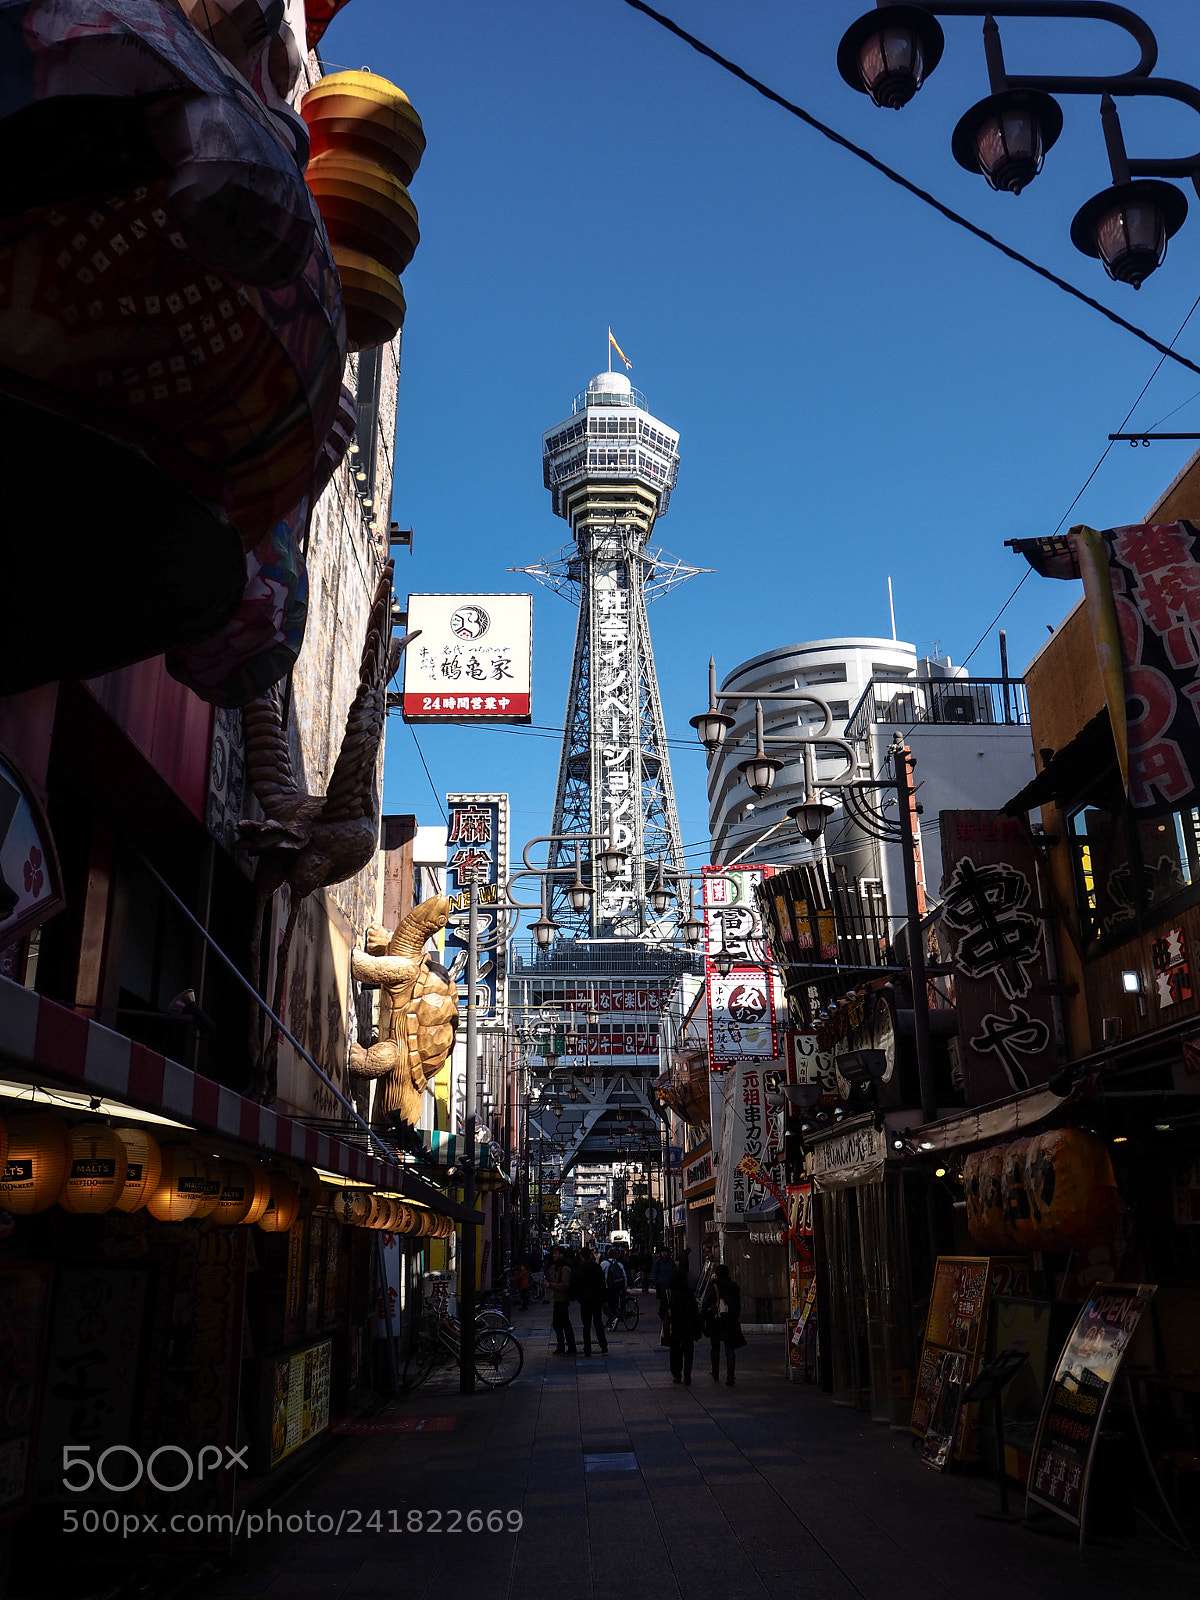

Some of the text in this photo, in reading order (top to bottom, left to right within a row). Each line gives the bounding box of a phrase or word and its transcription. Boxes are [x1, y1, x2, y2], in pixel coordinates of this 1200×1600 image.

[441, 655, 515, 681] 鶴亀家
[422, 696, 511, 710] 24時間営業中
[448, 804, 493, 886] 麻雀
[448, 884, 498, 911] NEW
[940, 854, 1051, 1092] 串や
[4, 1166, 24, 1176] LT'S
[76, 1164, 110, 1173] MALT'S
[1089, 1294, 1135, 1326] OPEN
